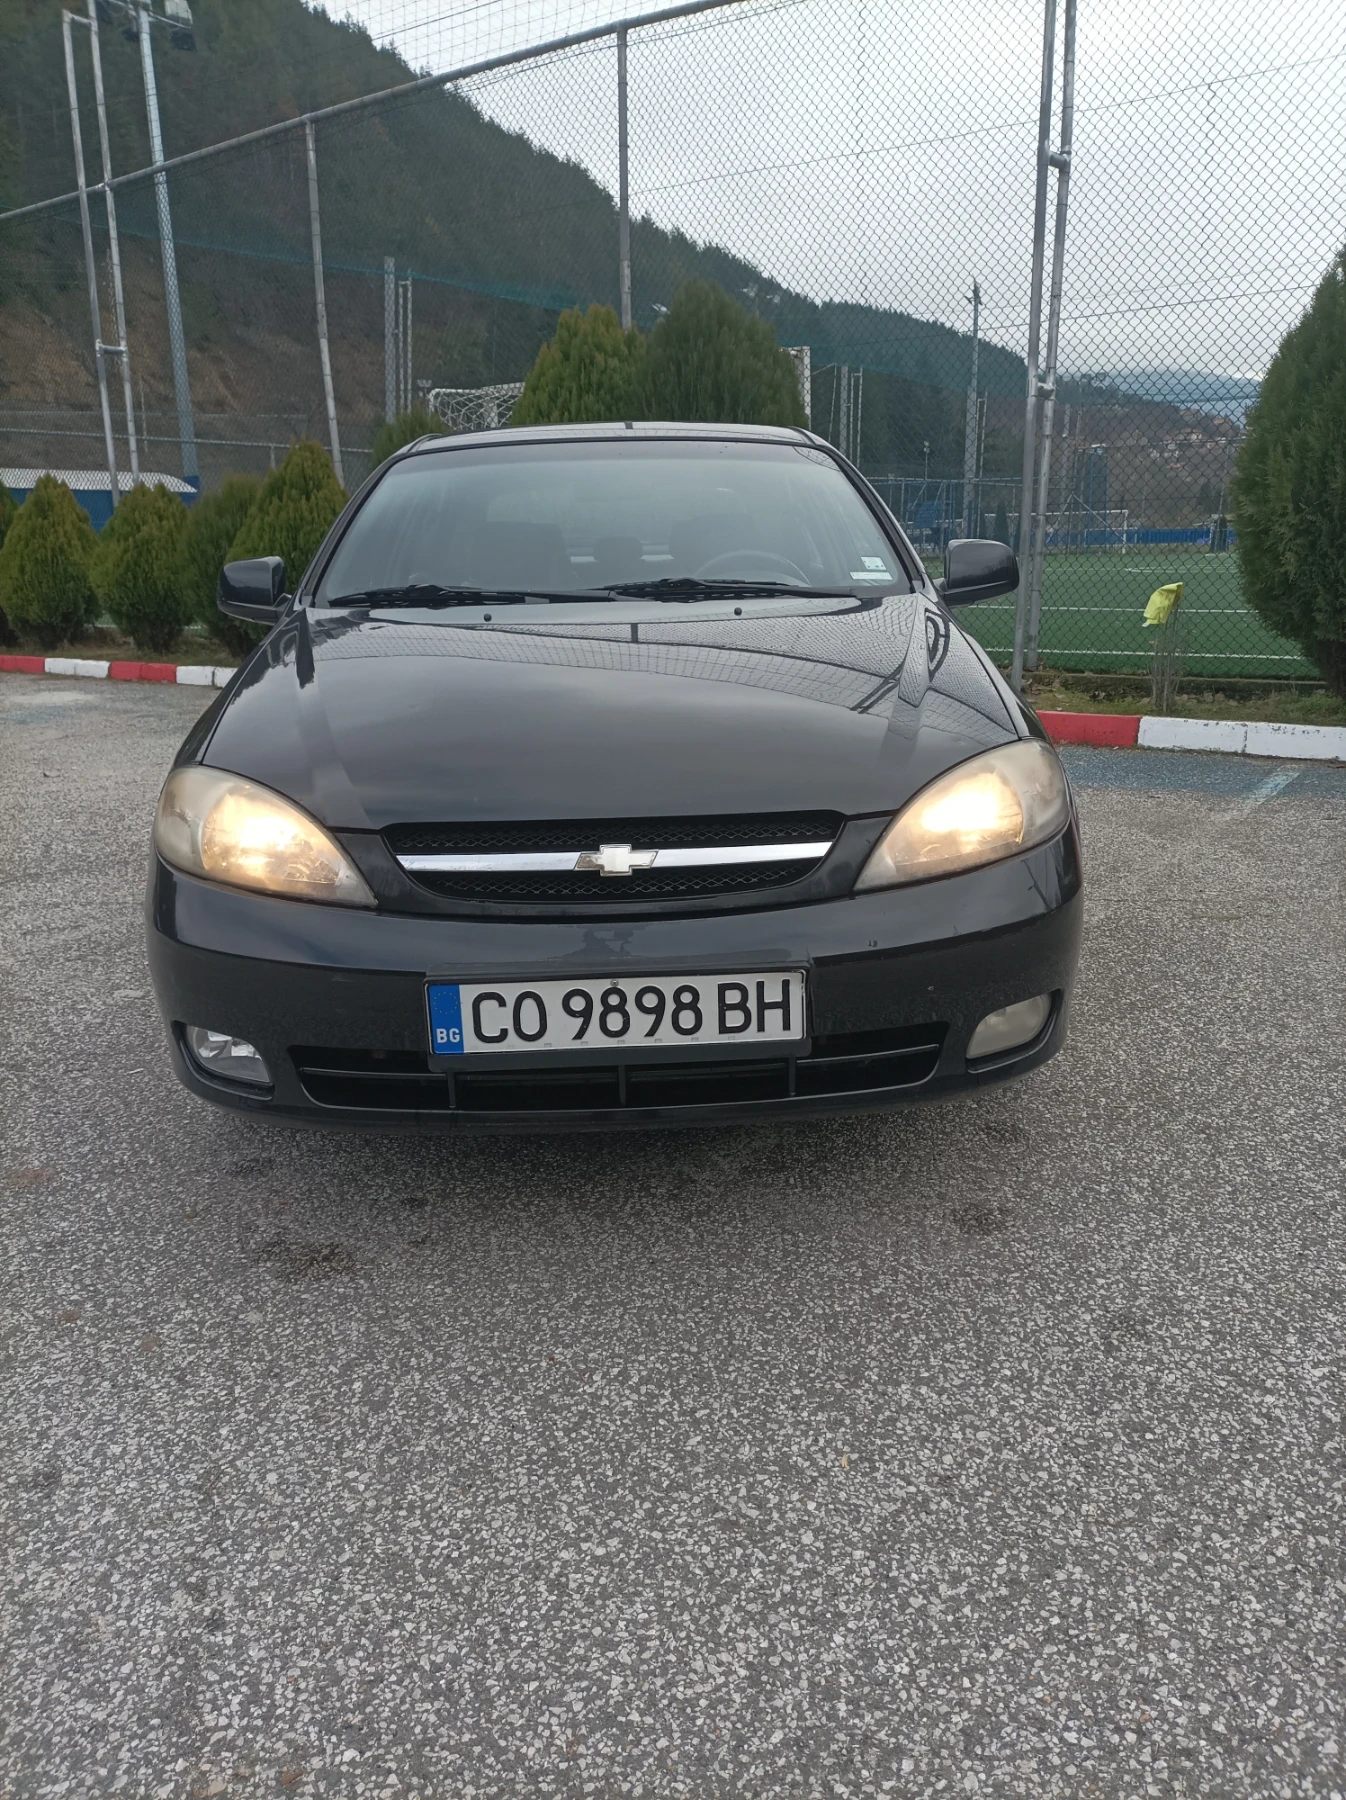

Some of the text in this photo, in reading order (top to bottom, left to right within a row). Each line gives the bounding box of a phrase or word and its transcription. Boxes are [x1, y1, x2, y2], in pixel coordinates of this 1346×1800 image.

[561, 984, 702, 1040] 9898
[717, 979, 791, 1034] BH
[436, 1028, 460, 1043] BG
